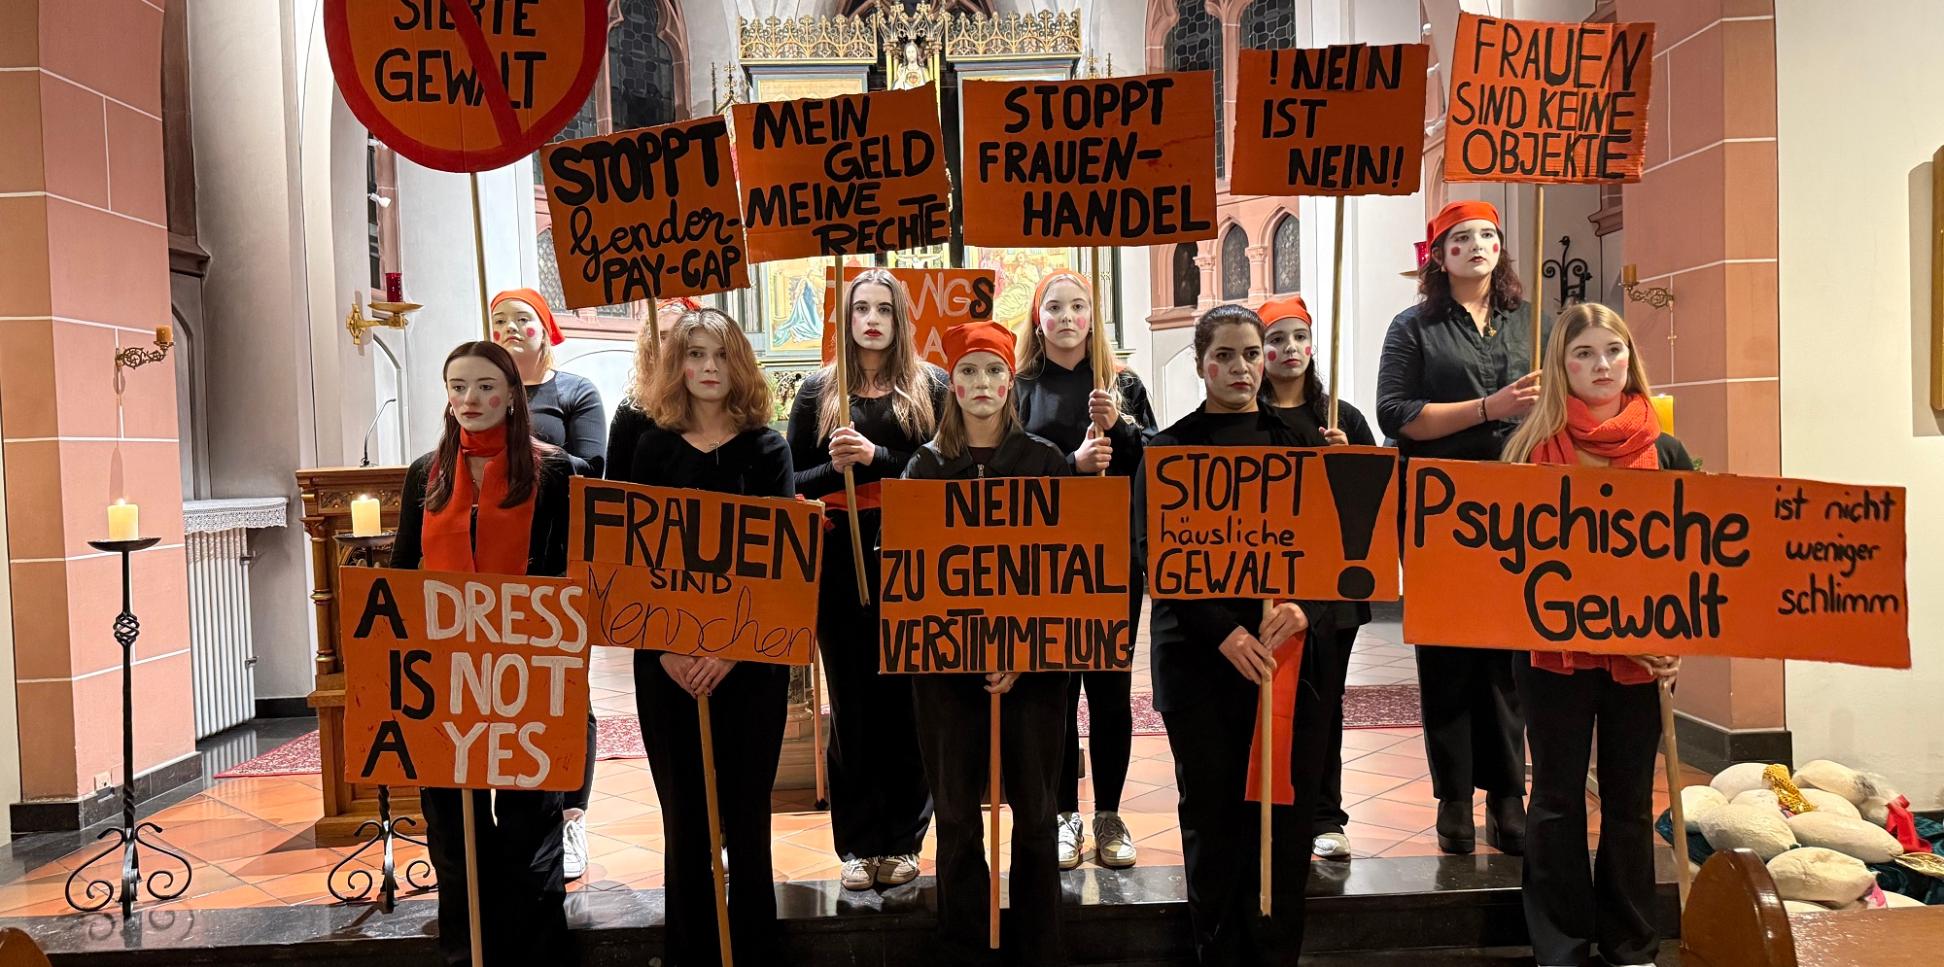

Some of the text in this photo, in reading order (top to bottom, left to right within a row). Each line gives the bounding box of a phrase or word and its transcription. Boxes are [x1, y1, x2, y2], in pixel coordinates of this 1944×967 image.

[1291, 48, 1403, 90] NEIN
[1473, 19, 1647, 90] FRAUEN
[753, 96, 871, 150] MEIN
[1003, 78, 1174, 133] STOPPT
[1262, 98, 1328, 139] IST
[1452, 81, 1636, 135] SIND KEINE
[549, 121, 727, 206] STOPPT
[824, 130, 935, 182] GELD
[978, 132, 1163, 185] FRAUEN-
[1288, 144, 1404, 189] NEIN!
[1463, 128, 1632, 179] OBJEKTE
[746, 183, 881, 228] MEINE
[812, 194, 947, 255] RECHTE
[1022, 185, 1210, 238] HANDEL
[570, 199, 739, 283] Gender-
[603, 246, 741, 303] PAY-GAP
[945, 478, 1060, 527] NEIN
[1157, 450, 1317, 516] STOPPT
[1774, 485, 1897, 522] ist nicht
[583, 486, 820, 583] FRAUEN
[1161, 513, 1295, 547] häusliche
[1323, 454, 1395, 600] !
[1414, 467, 1750, 575] Psychische
[650, 568, 732, 594] SIND
[883, 544, 1127, 602] ZU GENITAL
[1155, 548, 1304, 595] GEWALT
[1785, 531, 1881, 578] weniger
[354, 578, 587, 653] A DRESS
[588, 565, 817, 664] Menschen
[1524, 559, 1729, 642] Gewalt
[1777, 573, 1899, 616] schlimm
[882, 608, 1131, 673] VERSTIMMELUNG
[390, 650, 584, 720] IS NOT
[361, 720, 551, 788] A YES
